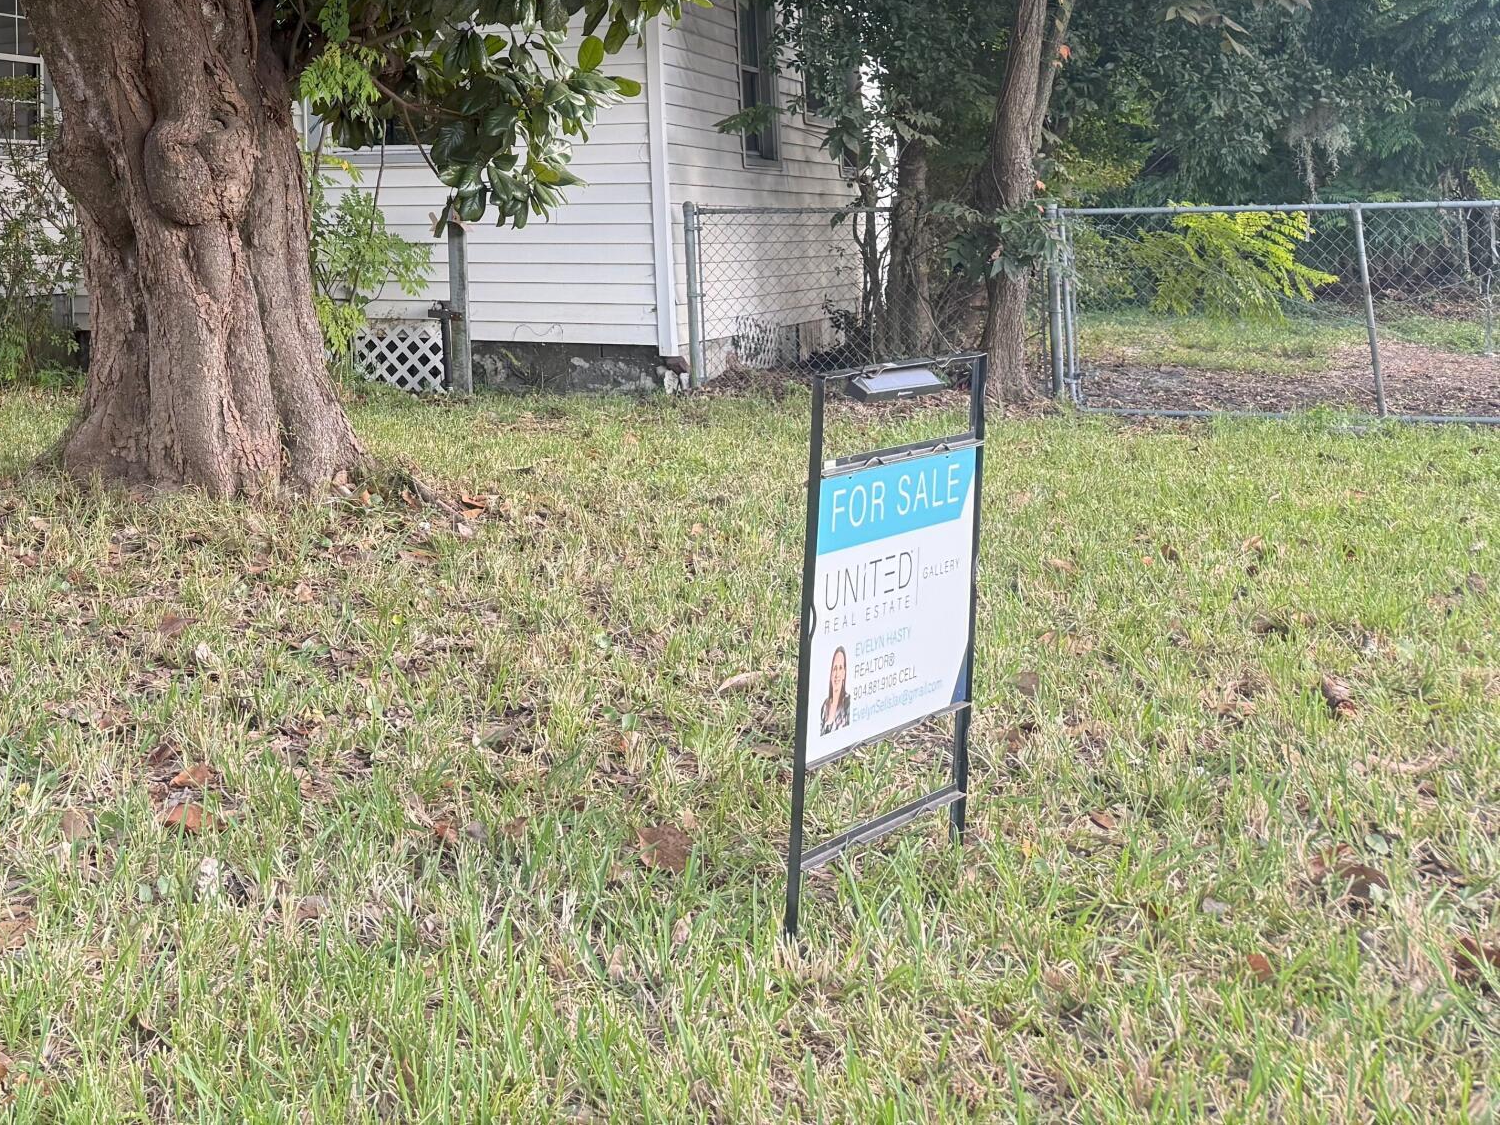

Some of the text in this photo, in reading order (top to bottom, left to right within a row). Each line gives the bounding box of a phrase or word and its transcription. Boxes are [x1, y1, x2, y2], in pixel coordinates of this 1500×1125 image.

[831, 463, 961, 533] FOR SALE
[825, 551, 961, 611] UNITED GALLERY
[824, 595, 911, 635] REAL ESTATE
[855, 626, 912, 658] EVELYN HASTY
[899, 665, 917, 684] CELL
